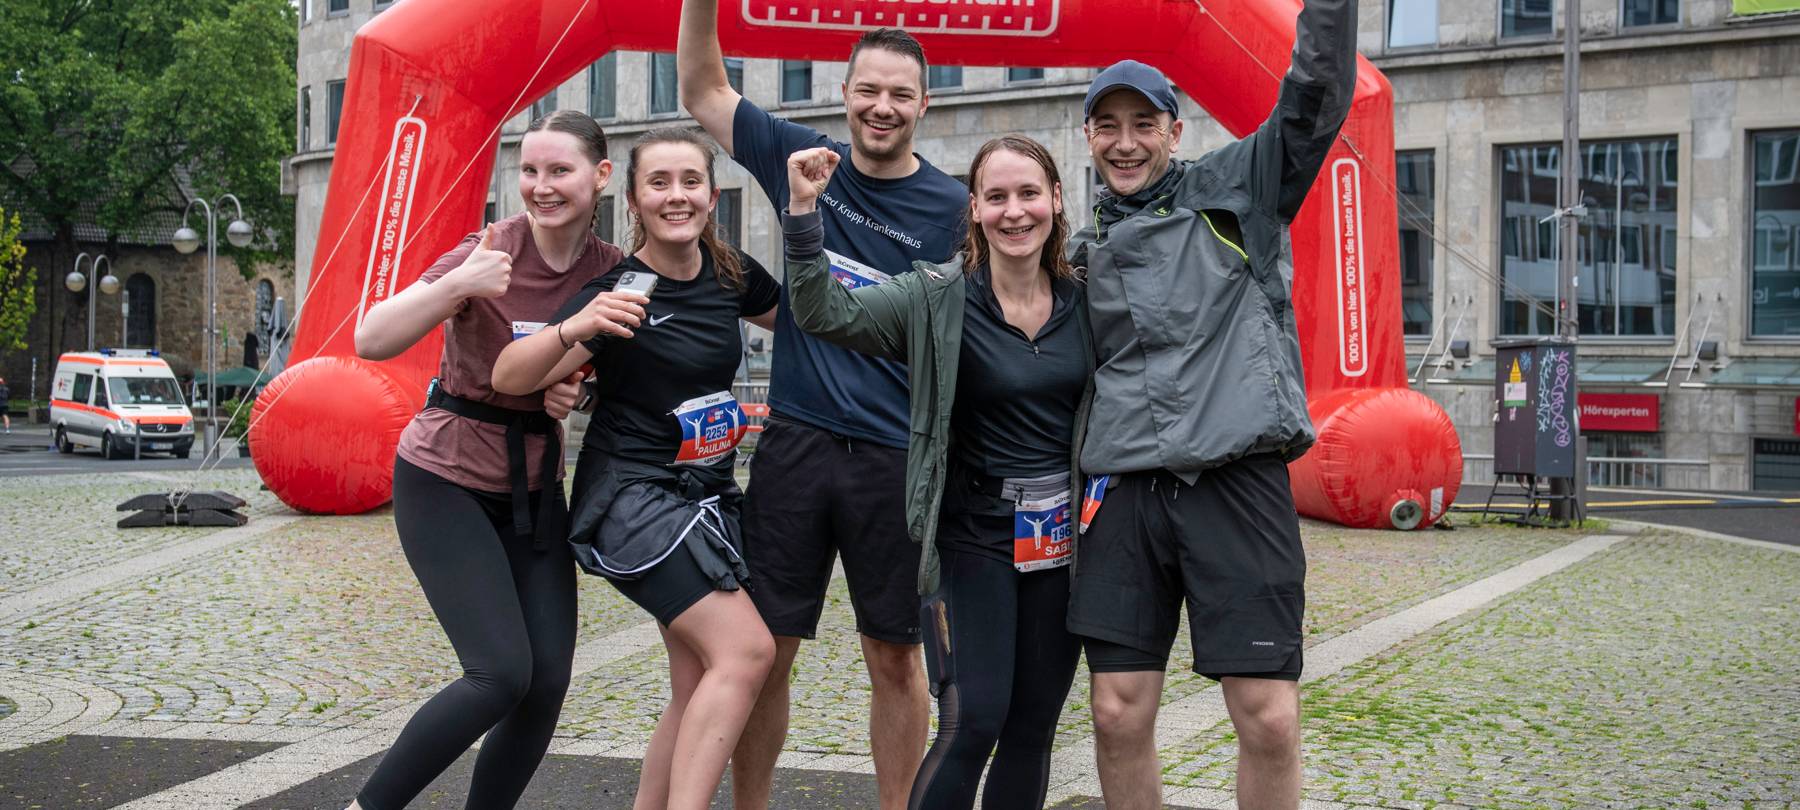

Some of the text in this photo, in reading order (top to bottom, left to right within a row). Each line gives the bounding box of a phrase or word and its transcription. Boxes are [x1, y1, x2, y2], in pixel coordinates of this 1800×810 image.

[399, 131, 416, 168] Musik.
[392, 168, 408, 200] beste
[1342, 171, 1352, 207] Musik.
[389, 200, 401, 218] die
[1344, 207, 1354, 237] beste
[382, 217, 398, 252] 100%
[837, 203, 864, 224] Krupp
[865, 216, 922, 249] Krankenhaus
[1345, 236, 1355, 255] die
[377, 252, 392, 279] hier.
[1346, 255, 1356, 287] 100%
[1348, 287, 1357, 310] hier.
[1349, 331, 1359, 364] 100%
[1583, 405, 1649, 419] Hörexperten
[706, 424, 727, 441] 2252
[697, 440, 732, 456] PAULINA
